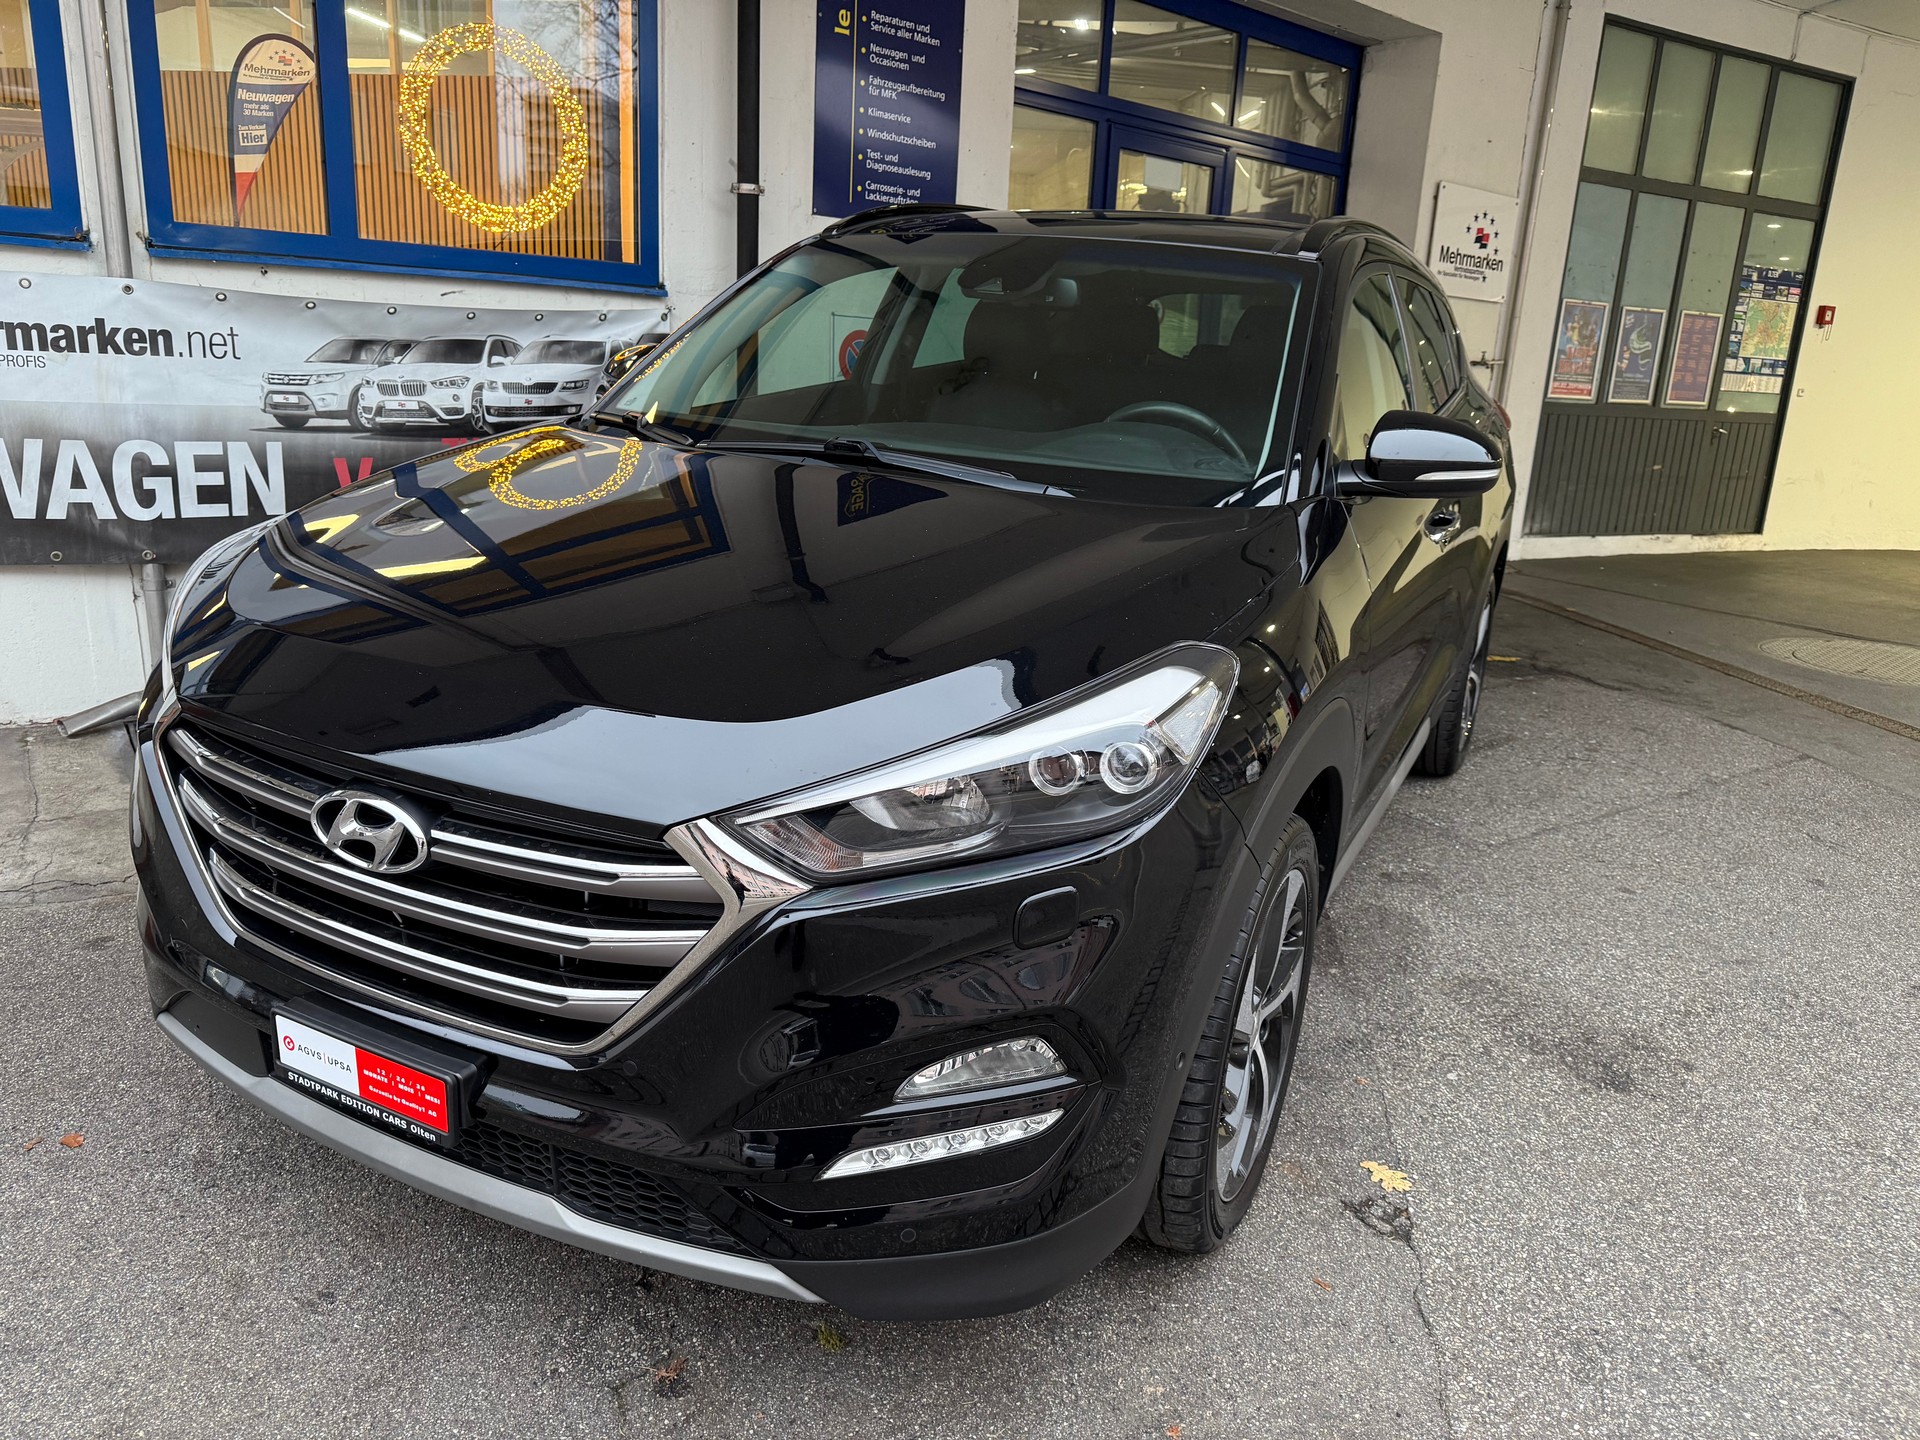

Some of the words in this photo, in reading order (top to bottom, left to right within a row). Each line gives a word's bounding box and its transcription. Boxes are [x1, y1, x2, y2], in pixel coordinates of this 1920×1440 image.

[834, 9, 850, 36] le
[871, 10, 915, 30] Reparaturen
[916, 23, 930, 33] und
[870, 21, 896, 35] Service
[897, 28, 913, 40] aller
[914, 32, 941, 47] Marken
[869, 54, 910, 71] Occasionen
[870, 42, 908, 60] Neuwagen
[911, 54, 926, 64] und
[244, 63, 310, 77] Mehrmarken
[237, 88, 295, 105] Neuwagen
[868, 75, 946, 101] Fahrzeugaufbereitung
[868, 85, 880, 96] für
[881, 88, 898, 100] MFK
[242, 108, 251, 116] 30
[252, 109, 274, 117] Marken
[868, 106, 912, 124] Klimaservice
[240, 131, 265, 144] Hier
[867, 127, 937, 149] Windschutzscheiben
[866, 148, 883, 159] Test-
[884, 153, 899, 163] und
[866, 159, 932, 181] Diagnoseauslesung
[865, 180, 906, 195] Carrosserie-
[906, 188, 921, 197] und
[1439, 245, 1504, 272] Mehrmarken
[0, 318, 241, 360] marken.net
[376, 1068, 386, 1076] 12
[363, 1069, 388, 1083] MONATE
[398, 1083, 415, 1094] MOIS
[424, 1093, 441, 1105] MESI
[287, 1071, 339, 1100] STADTPARK
[340, 1094, 380, 1118] EDITION
[382, 1112, 407, 1129] CARS
[410, 1124, 436, 1142] Olten
[368, 1085, 393, 1099] Garantie
[393, 1095, 401, 1103] by
[401, 1098, 425, 1112] Quality1
[428, 1109, 437, 1118] AG
